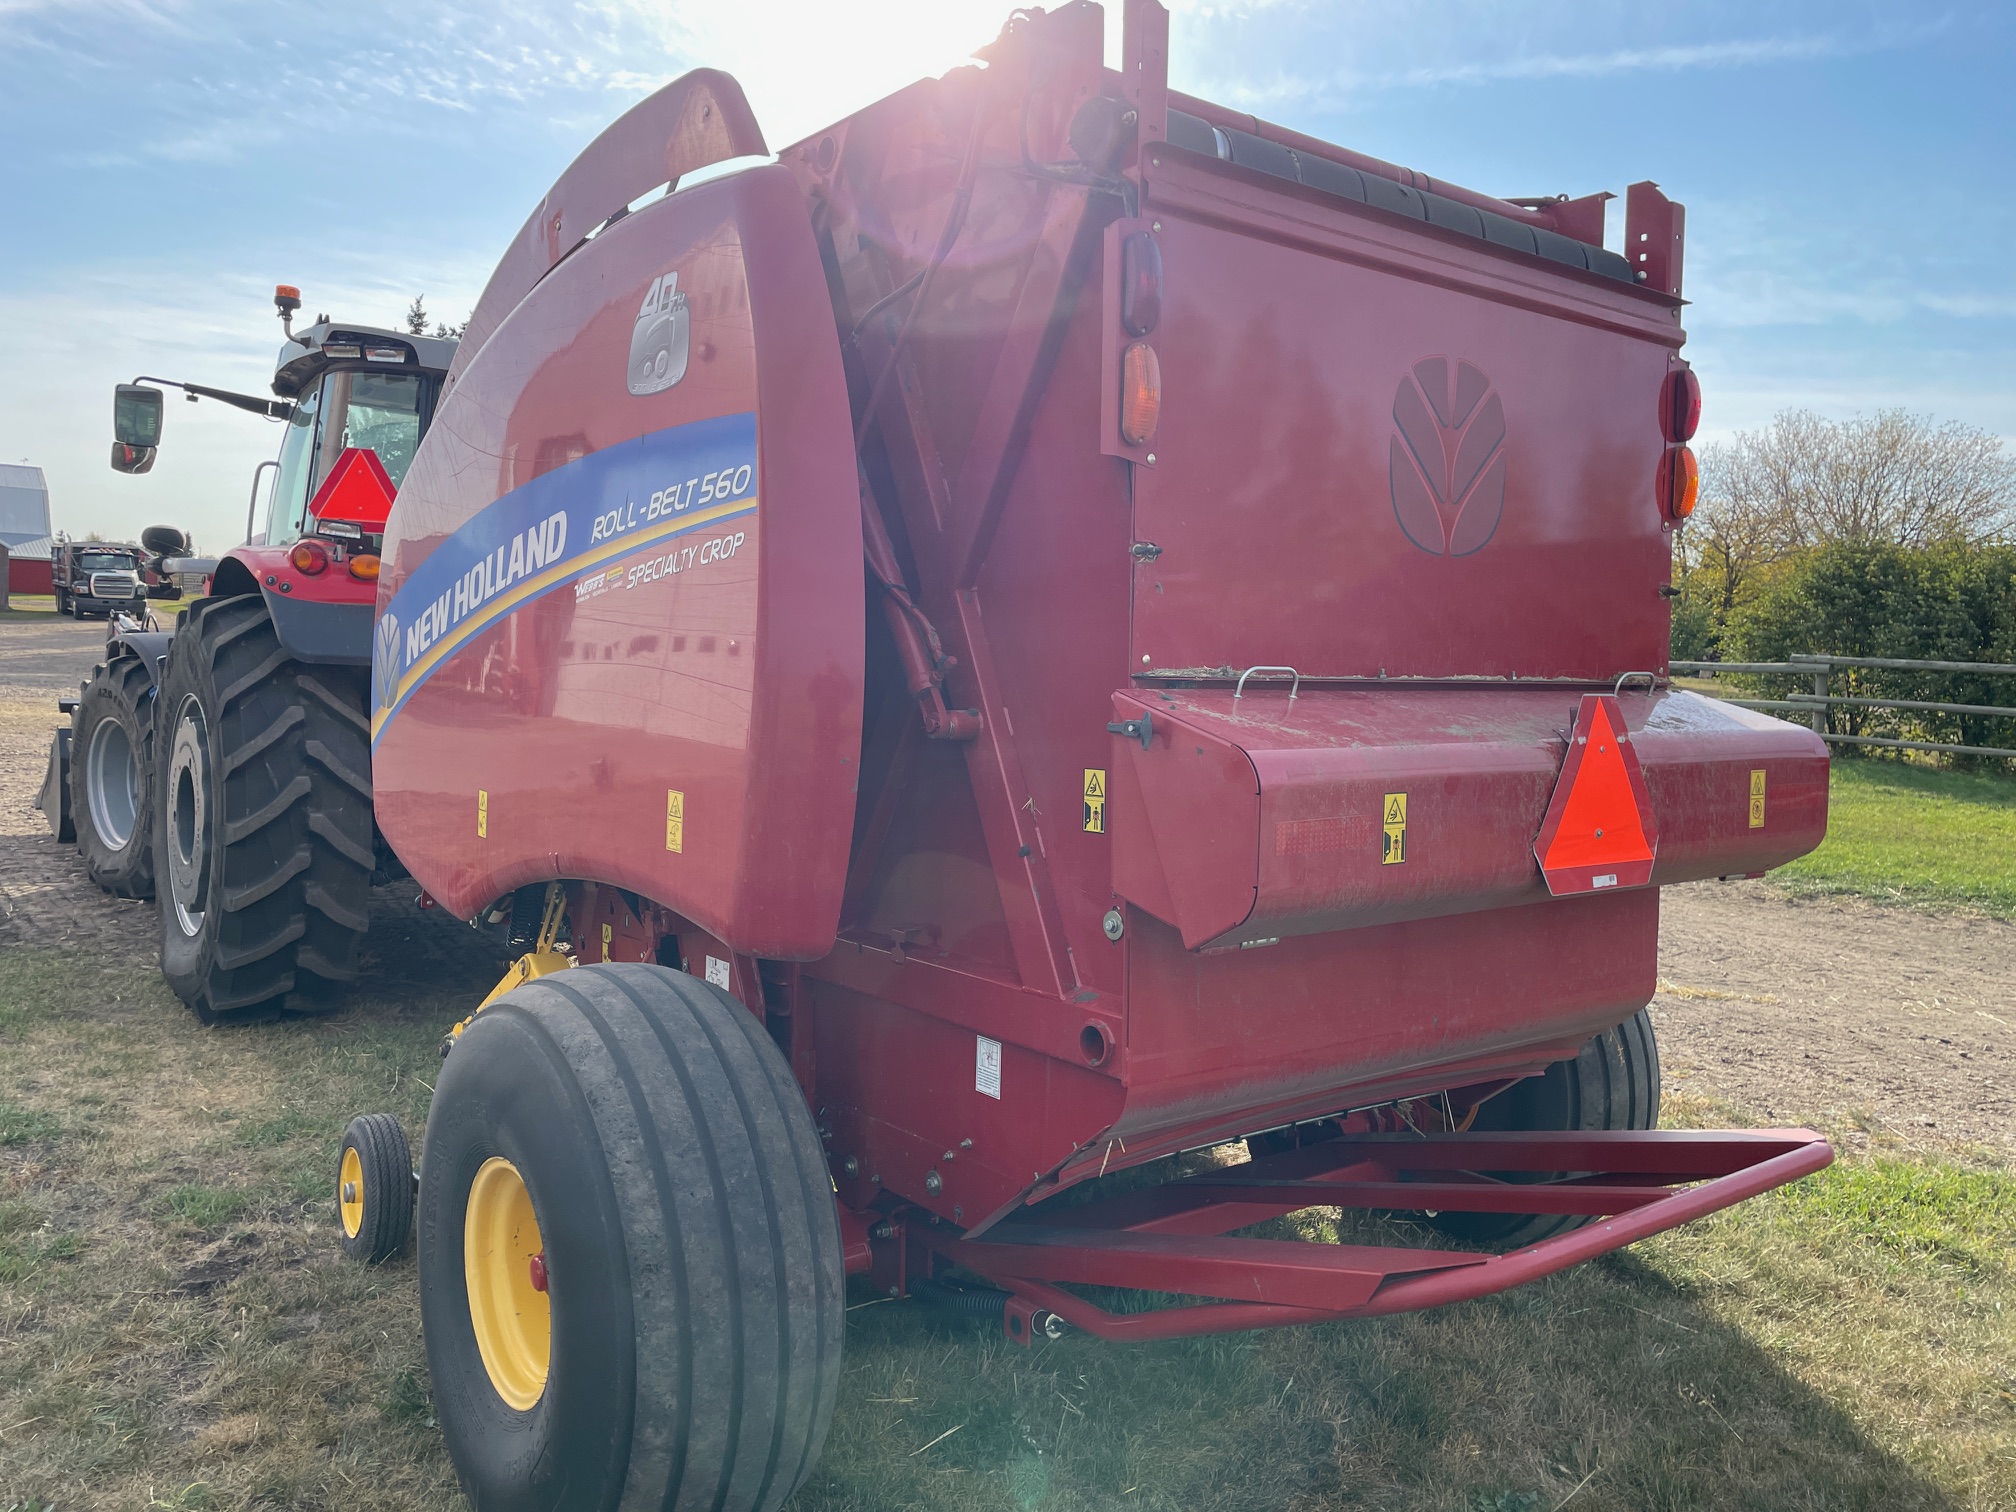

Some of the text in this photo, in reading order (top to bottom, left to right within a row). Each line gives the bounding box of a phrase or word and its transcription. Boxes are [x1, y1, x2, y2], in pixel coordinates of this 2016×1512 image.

[698, 464, 752, 505] 560
[406, 510, 567, 667] NEW HOLLAND
[626, 544, 699, 590] SPECIALTY
[700, 532, 745, 565] CROP
